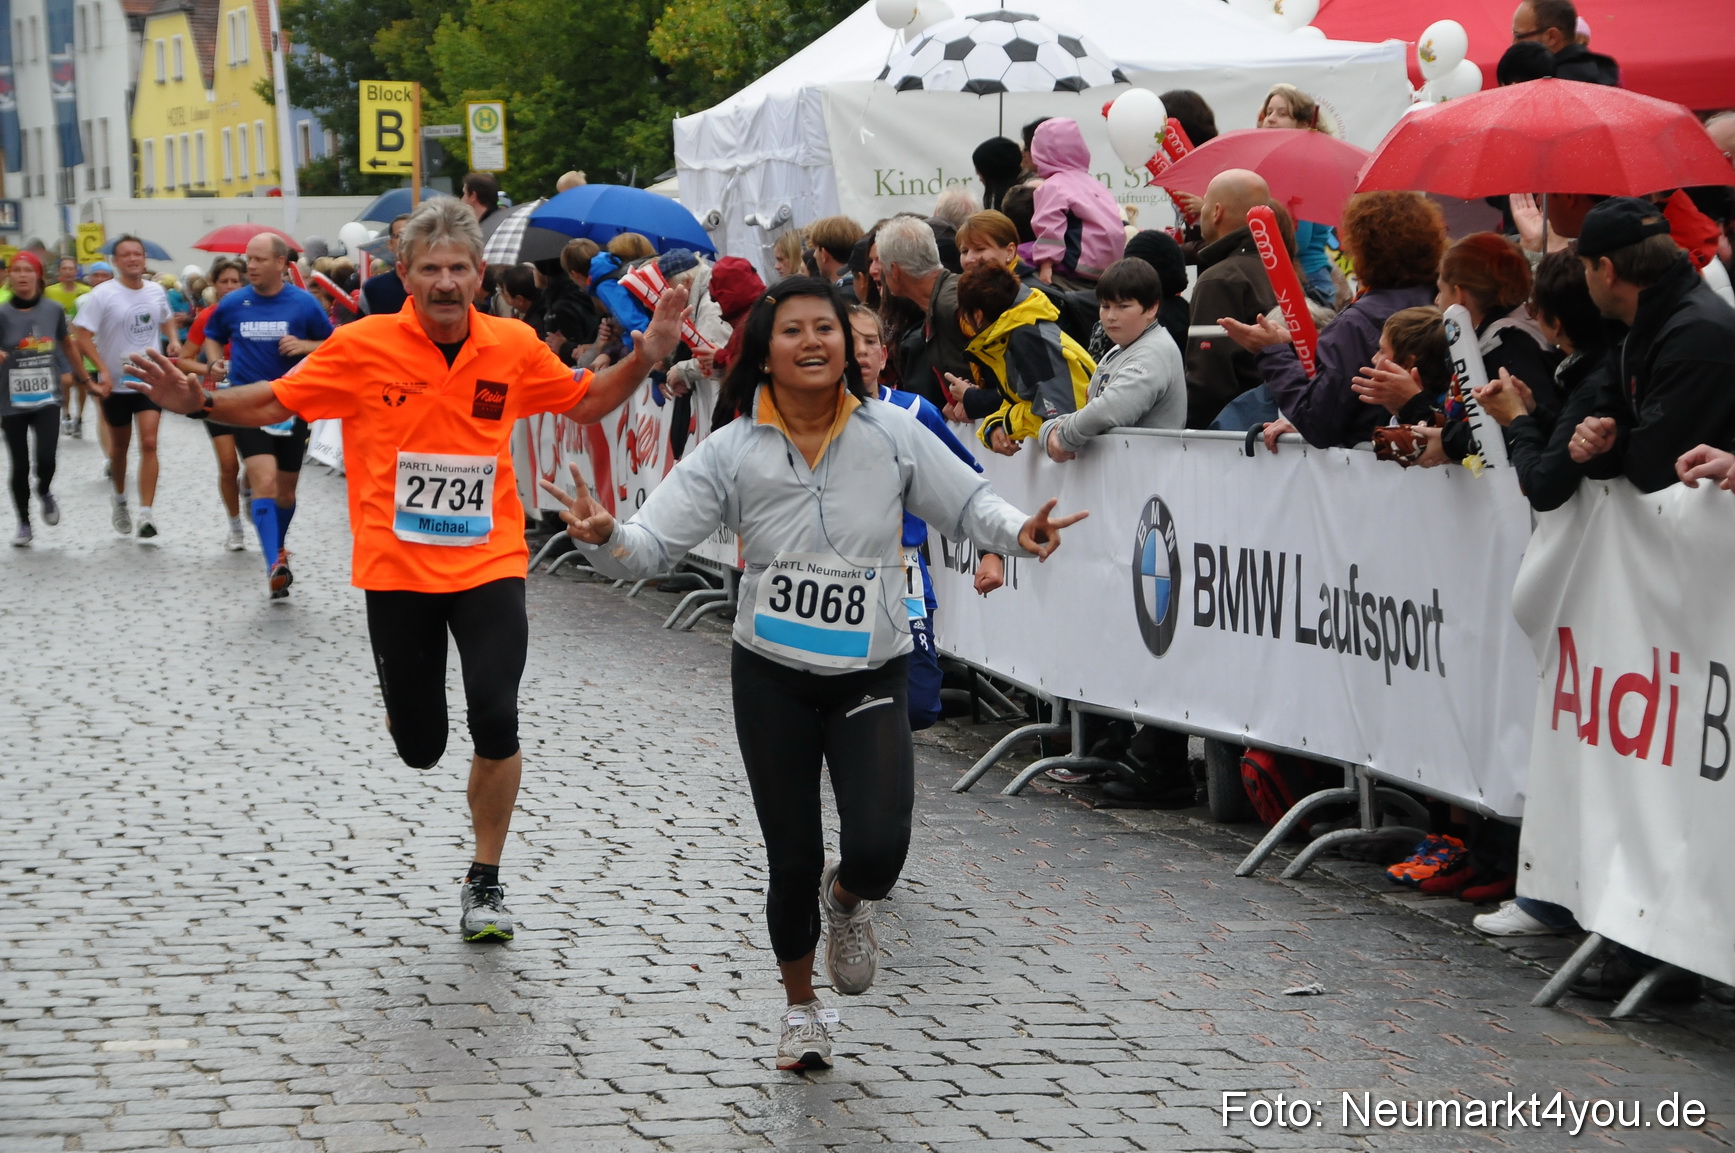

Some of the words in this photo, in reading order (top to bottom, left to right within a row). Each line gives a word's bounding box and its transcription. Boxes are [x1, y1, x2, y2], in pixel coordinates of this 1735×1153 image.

[367, 84, 413, 102] Block
[376, 108, 405, 152] B
[83, 235, 97, 255] C
[1277, 288, 1301, 332] BKK
[240, 321, 288, 331] HUBER
[1294, 338, 1317, 379] udi
[14, 377, 49, 393] 3088
[399, 461, 433, 472] PARTL
[435, 464, 480, 474] Neumarkt
[405, 475, 484, 511] 2734
[418, 517, 469, 534] Michael
[1137, 500, 1177, 554] BMW
[771, 559, 804, 572] ARTL
[807, 563, 862, 579] Neumarkt
[768, 574, 866, 626] 3068
[1193, 542, 1286, 639] BMW
[1295, 553, 1447, 686] Laufsport
